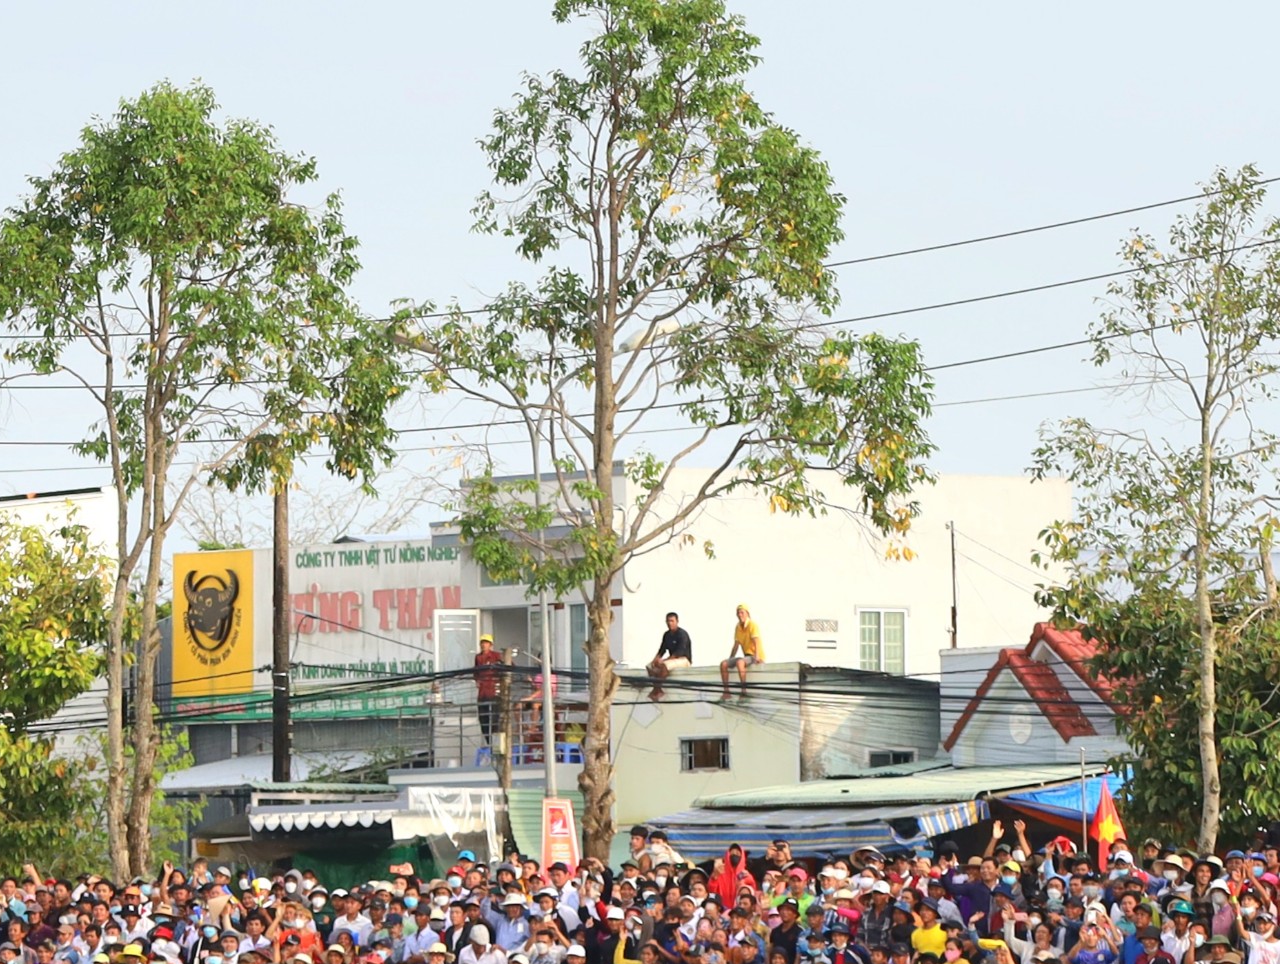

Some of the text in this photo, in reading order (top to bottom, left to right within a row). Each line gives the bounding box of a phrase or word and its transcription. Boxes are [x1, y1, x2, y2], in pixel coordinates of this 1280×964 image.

[295, 548, 322, 569] CÔNG
[323, 551, 337, 568] TY
[337, 549, 363, 567] TNHH
[364, 544, 381, 569] VẬT
[383, 543, 397, 565] TƯ
[398, 542, 426, 563] NÔNG
[288, 582, 363, 635] ƯNG
